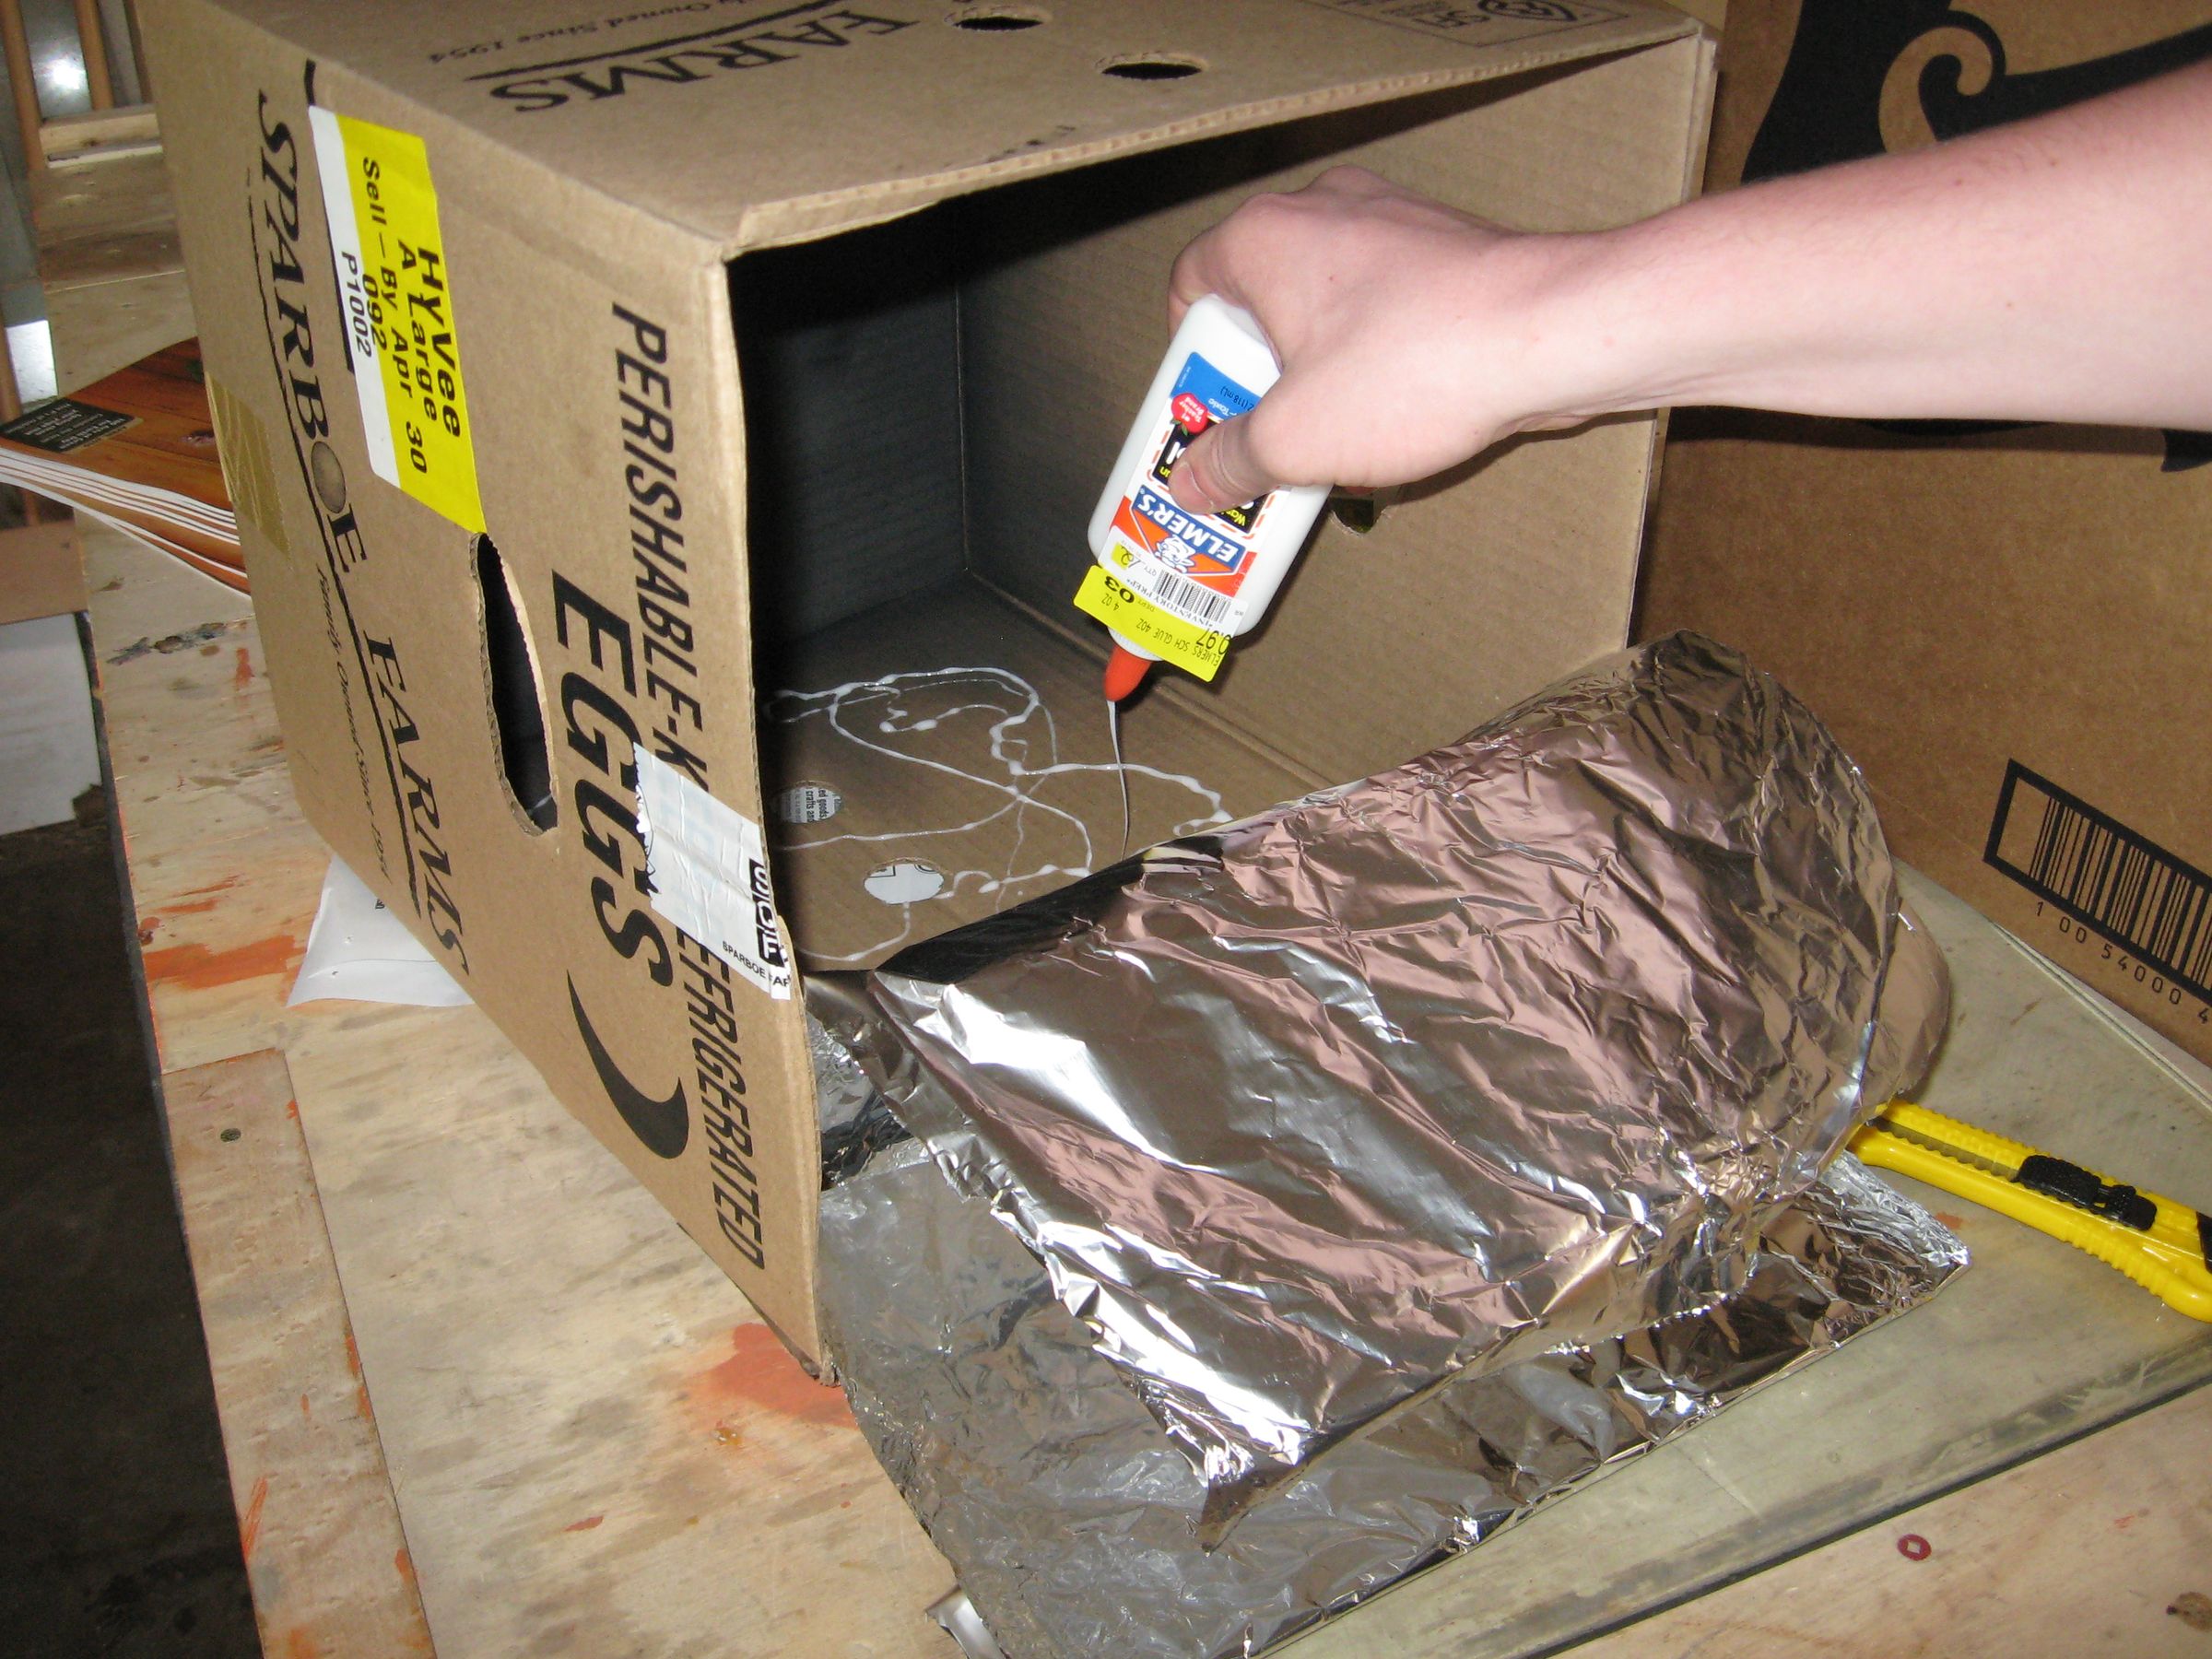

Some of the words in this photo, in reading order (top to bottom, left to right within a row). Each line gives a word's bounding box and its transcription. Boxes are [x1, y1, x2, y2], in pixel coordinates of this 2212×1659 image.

[489, 10, 920, 112] FARMS
[397, 239, 418, 270] A
[342, 251, 372, 359] P1002
[362, 273, 387, 351] 092
[362, 158, 387, 226] Sell
[381, 265, 398, 311] By
[392, 326, 413, 398] Apr
[406, 420, 428, 476] 30
[407, 291, 438, 421] Large
[1138, 494, 1239, 562] ELMER'S
[1104, 575, 1135, 604] 03
[1153, 628, 1172, 644] GLUE
[1174, 638, 1191, 652] SCH
[1192, 645, 1221, 666] ELMERS
[1196, 629, 1232, 655] 0.97
[363, 629, 470, 976] FARMS
[552, 568, 674, 988] EGGS
[612, 301, 709, 794] PERISHABLE-K
[676, 925, 766, 1270] EFRIGERATED
[723, 941, 766, 979] SPARBOE
